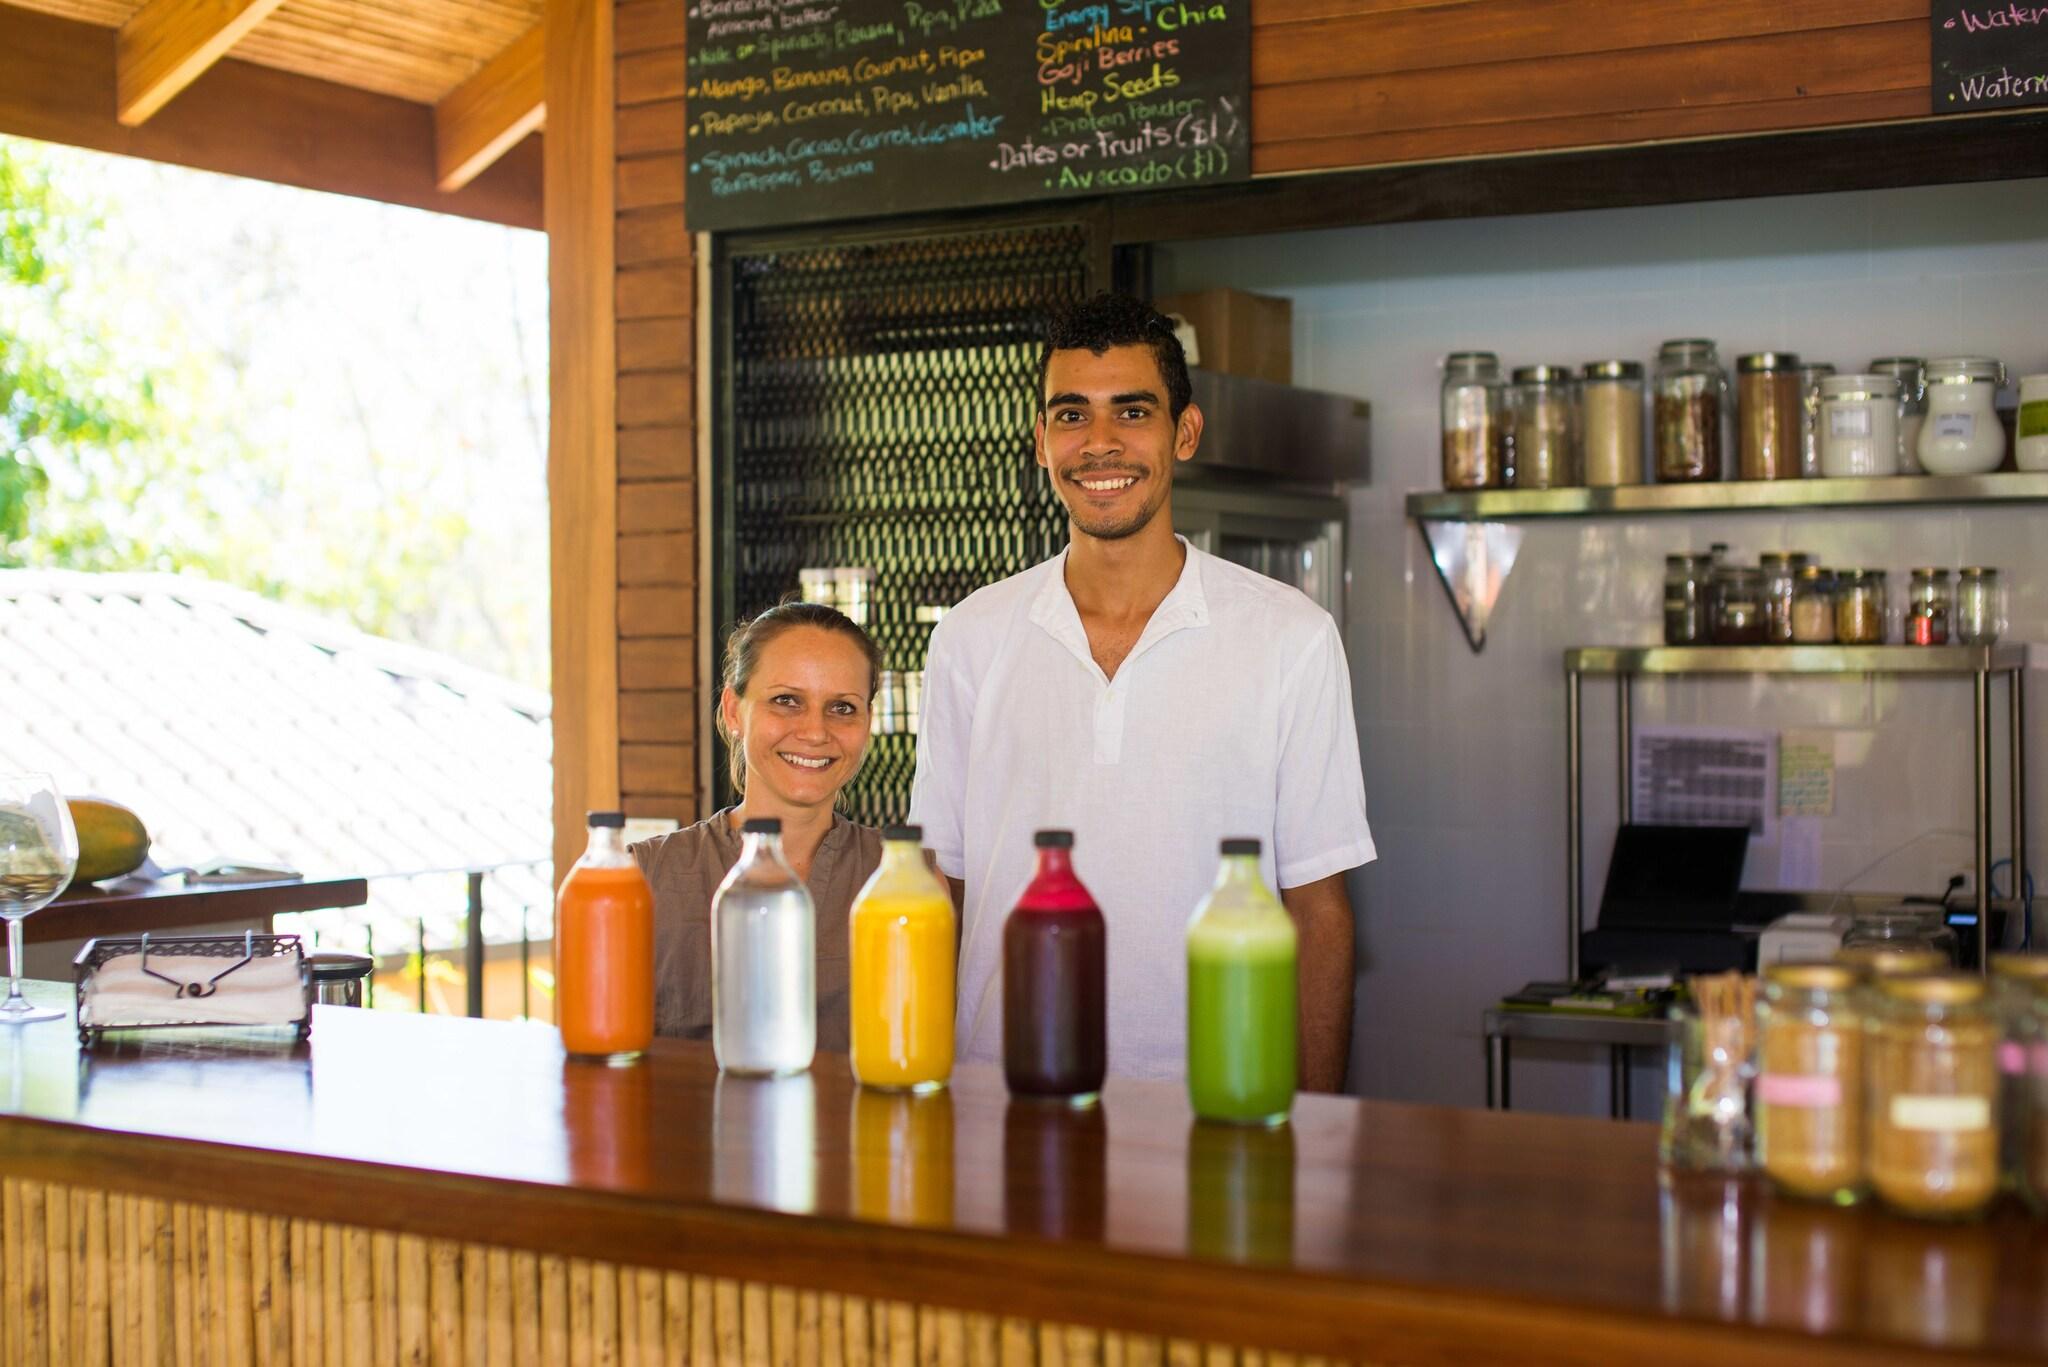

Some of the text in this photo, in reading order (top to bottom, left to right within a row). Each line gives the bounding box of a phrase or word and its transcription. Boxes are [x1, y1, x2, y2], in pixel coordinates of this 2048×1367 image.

[1157, 3, 1227, 31] Chia
[1099, 39, 1180, 70] Berries
[1041, 63, 1181, 115] Hemp Seeds
[1000, 135, 1058, 172] Dates
[1061, 143, 1090, 159] or
[1059, 160, 1173, 190] Avocado
